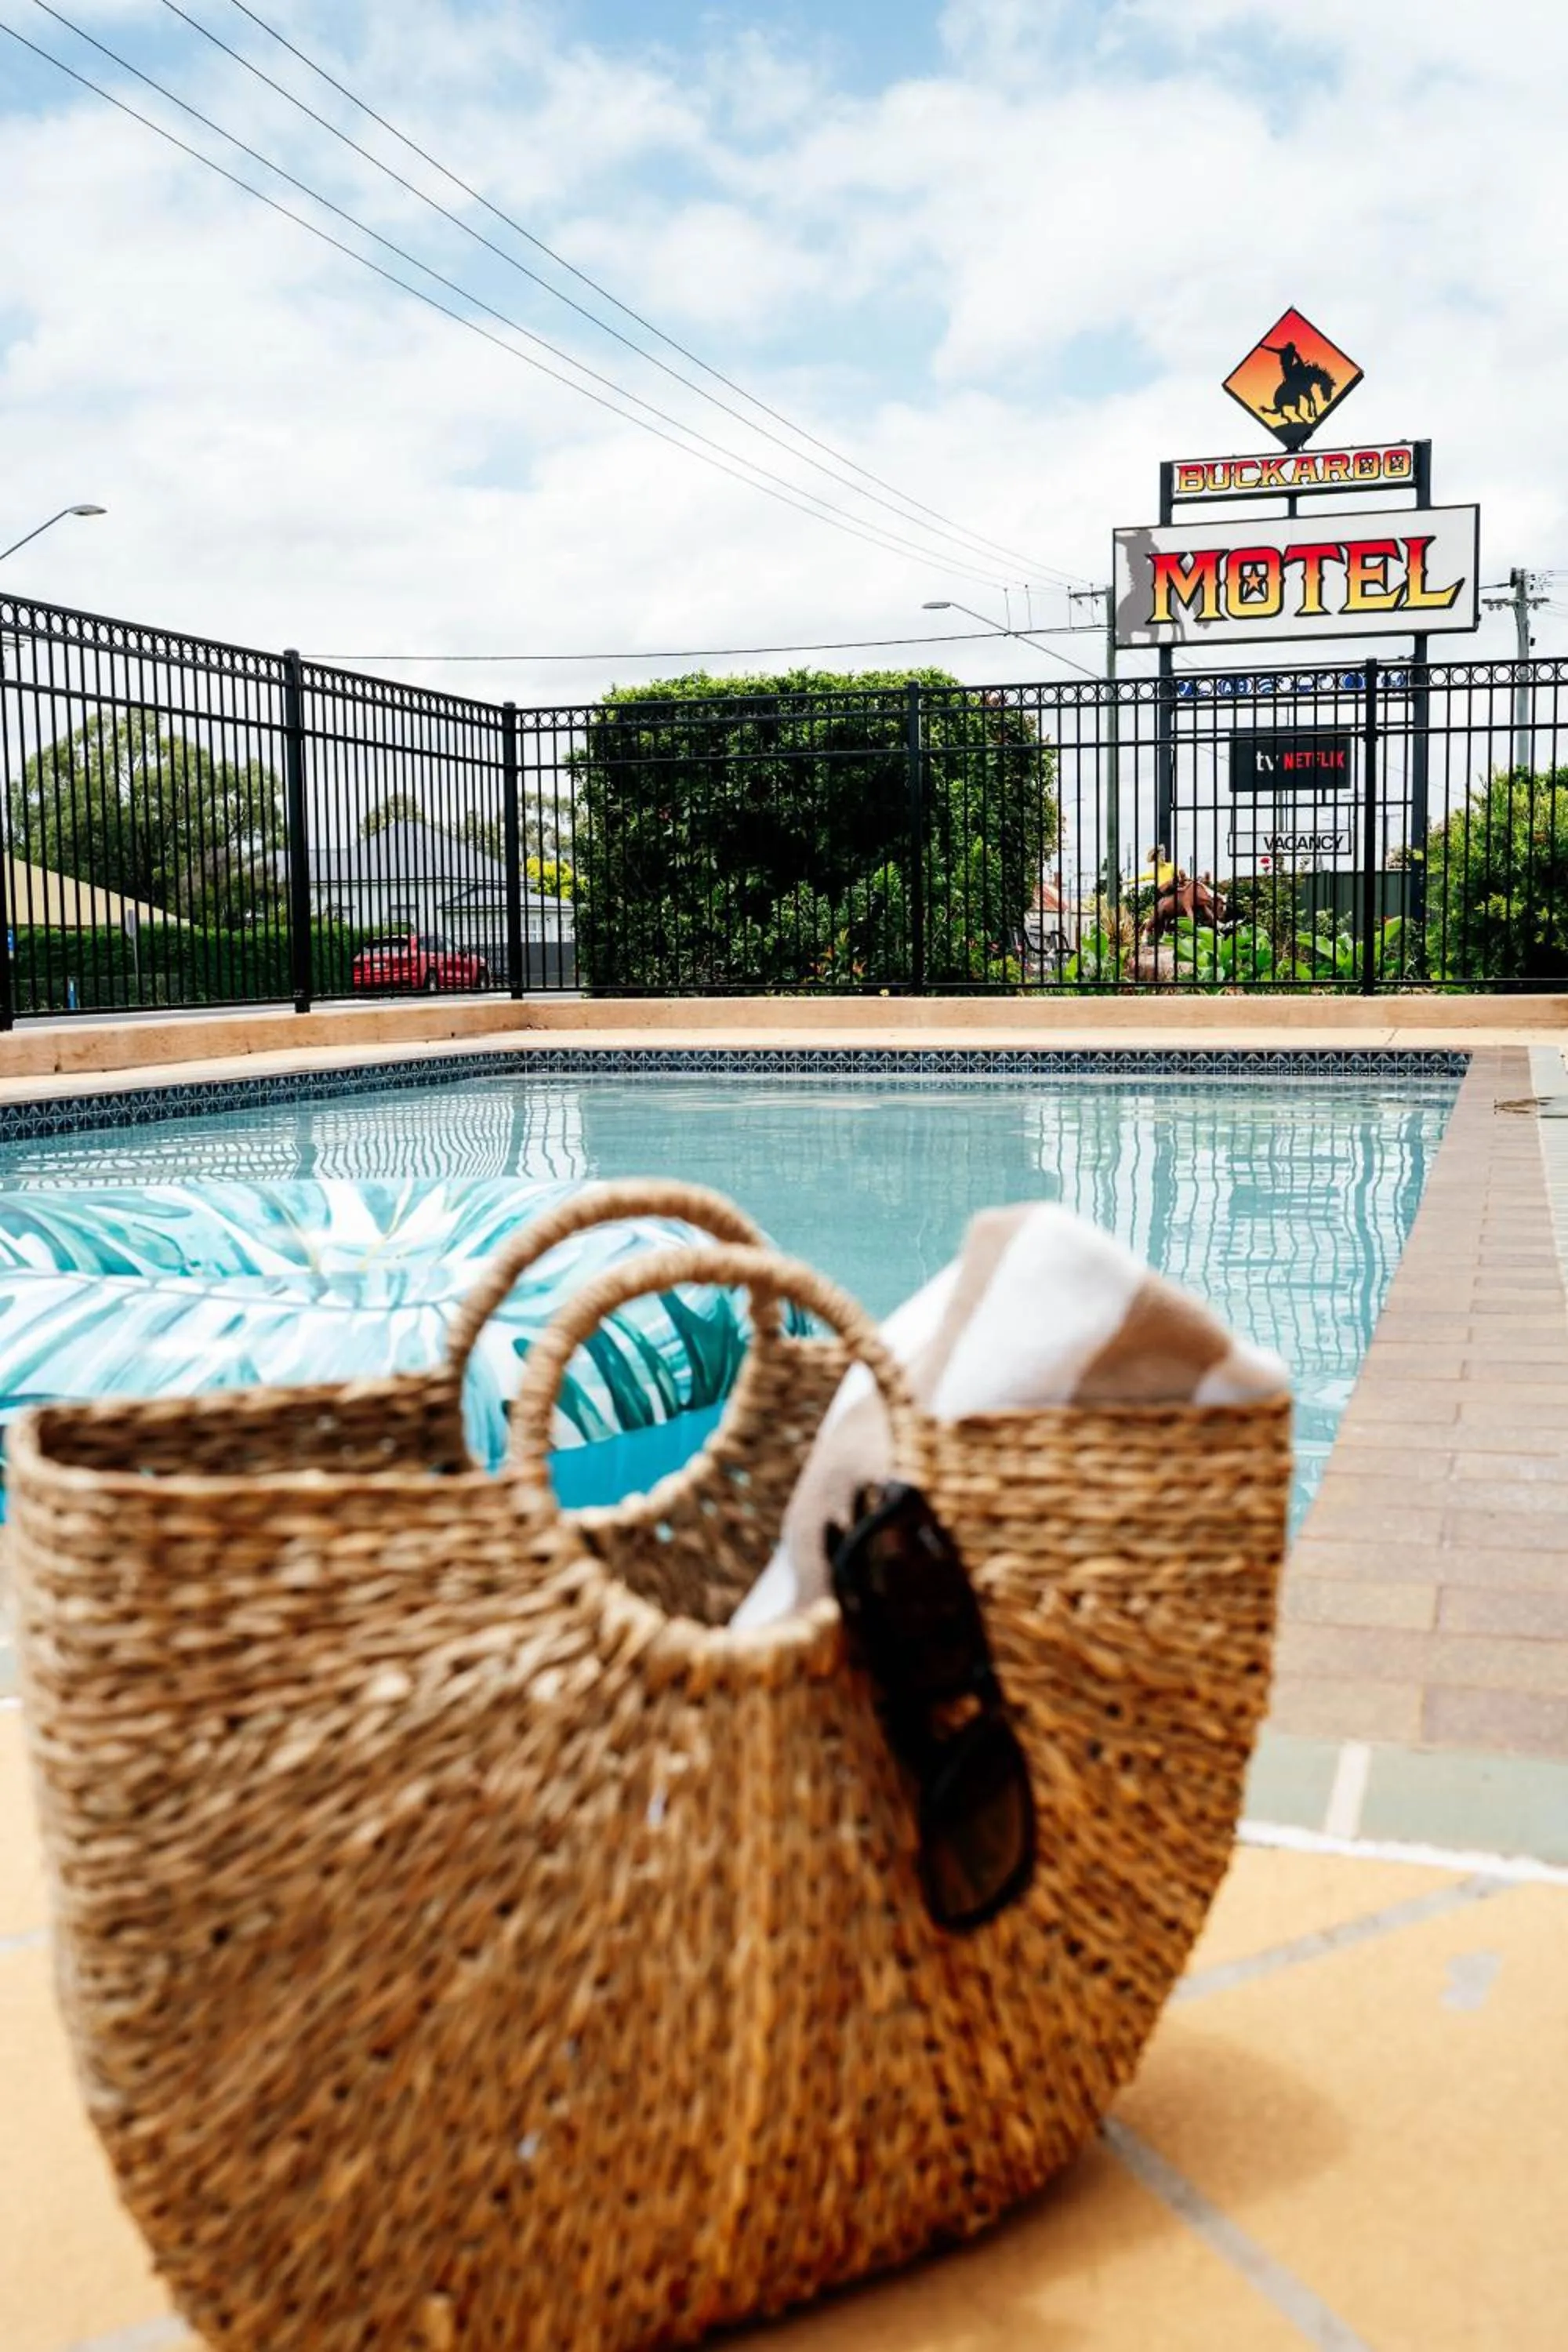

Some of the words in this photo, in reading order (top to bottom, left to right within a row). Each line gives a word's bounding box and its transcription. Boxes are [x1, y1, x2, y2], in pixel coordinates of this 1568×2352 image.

[1176, 449, 1412, 493] BUCKAROO
[1145, 535, 1465, 624] MOTEL
[1264, 835, 1344, 851] VACANCY
